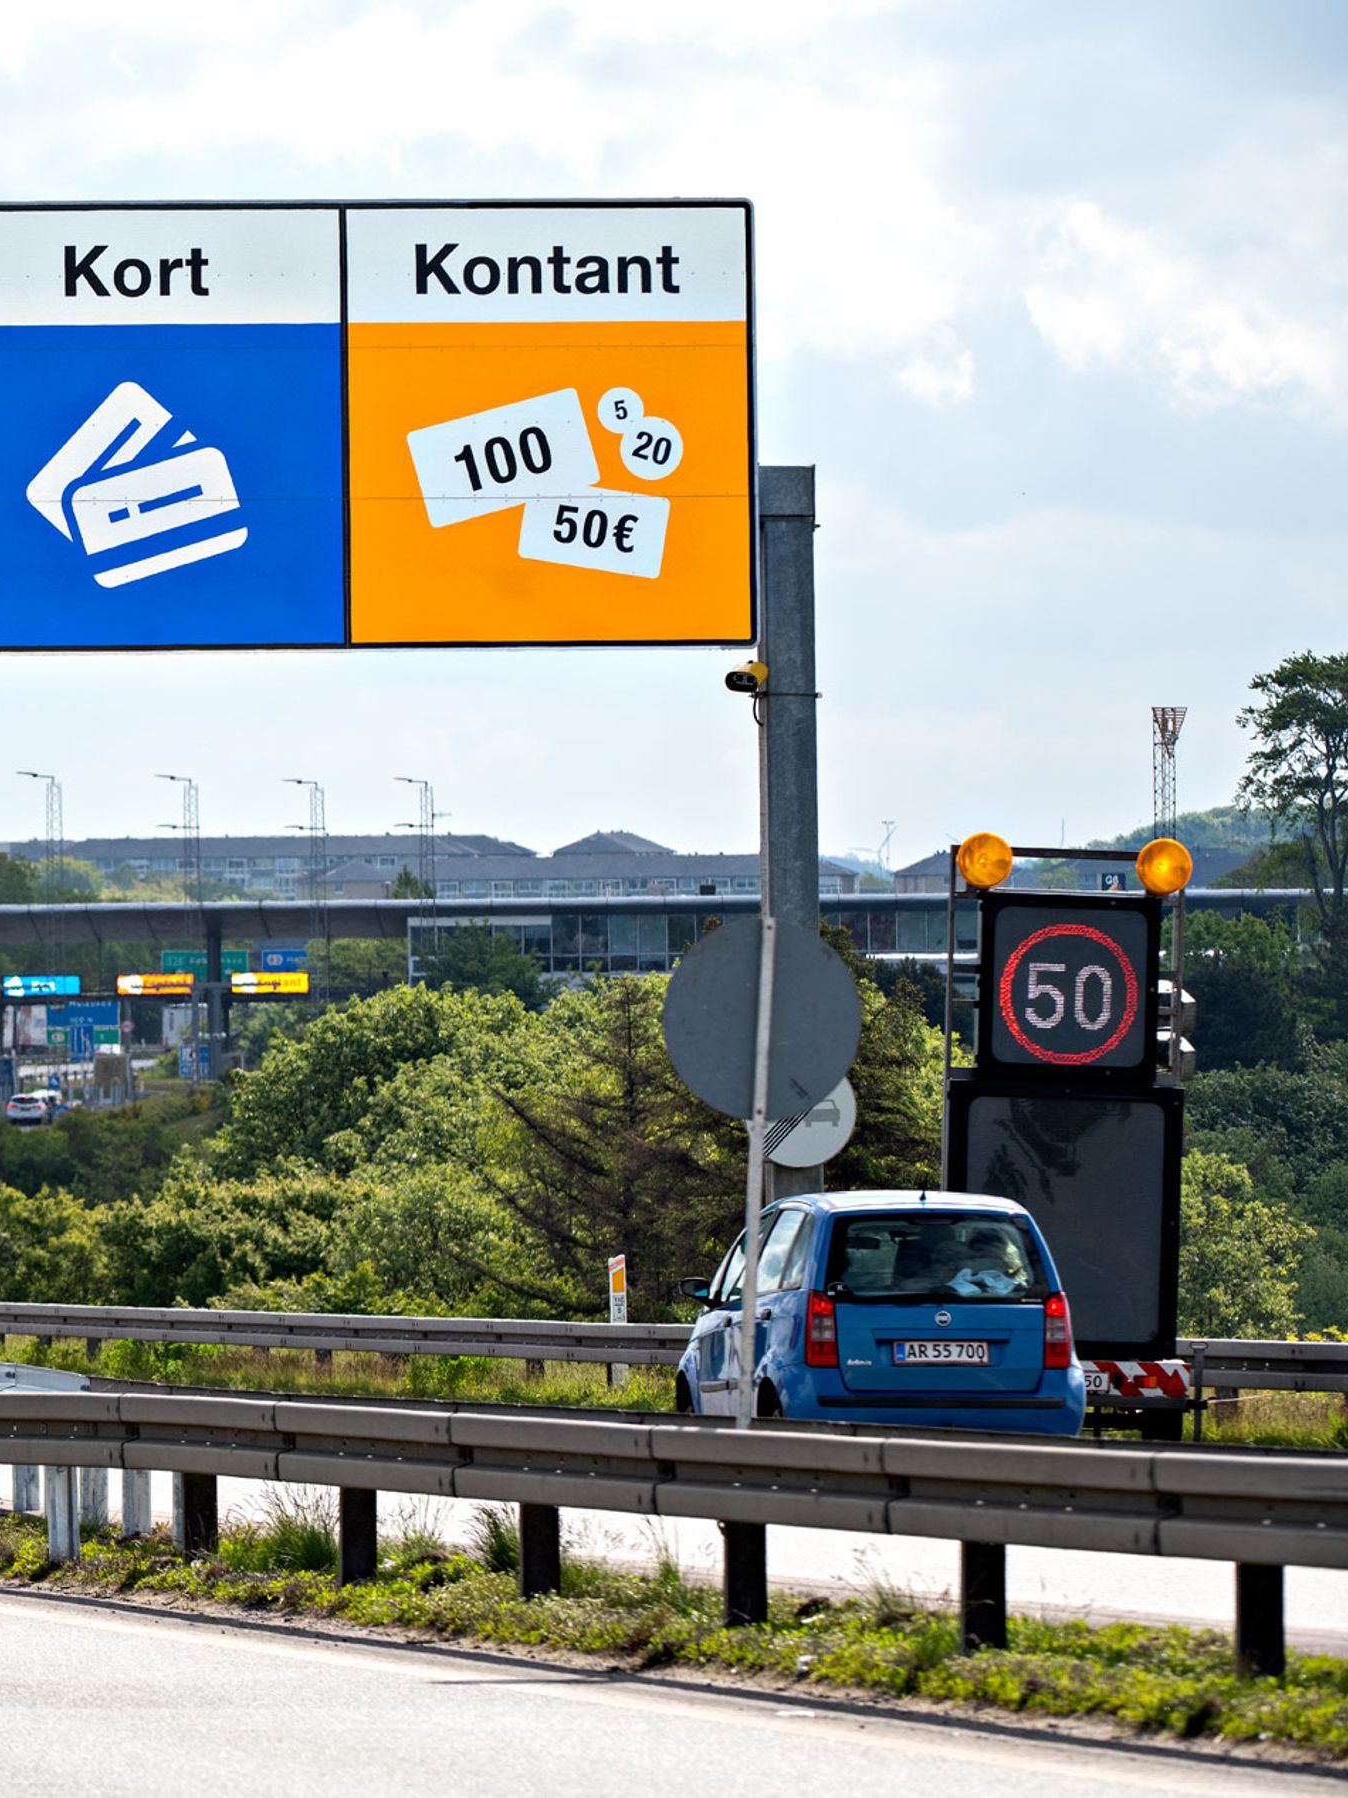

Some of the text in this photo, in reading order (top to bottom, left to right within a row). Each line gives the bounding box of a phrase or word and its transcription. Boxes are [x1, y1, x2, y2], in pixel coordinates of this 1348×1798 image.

[63, 245, 210, 298] Kort
[414, 243, 680, 296] Kontant
[613, 399, 628, 421] 5
[454, 426, 552, 491] 100
[631, 431, 672, 466] 20
[553, 504, 639, 554] 50€
[1024, 962, 1113, 1031] 50
[906, 1343, 986, 1360] AR 55 700
[1084, 1375, 1103, 1388] 50
